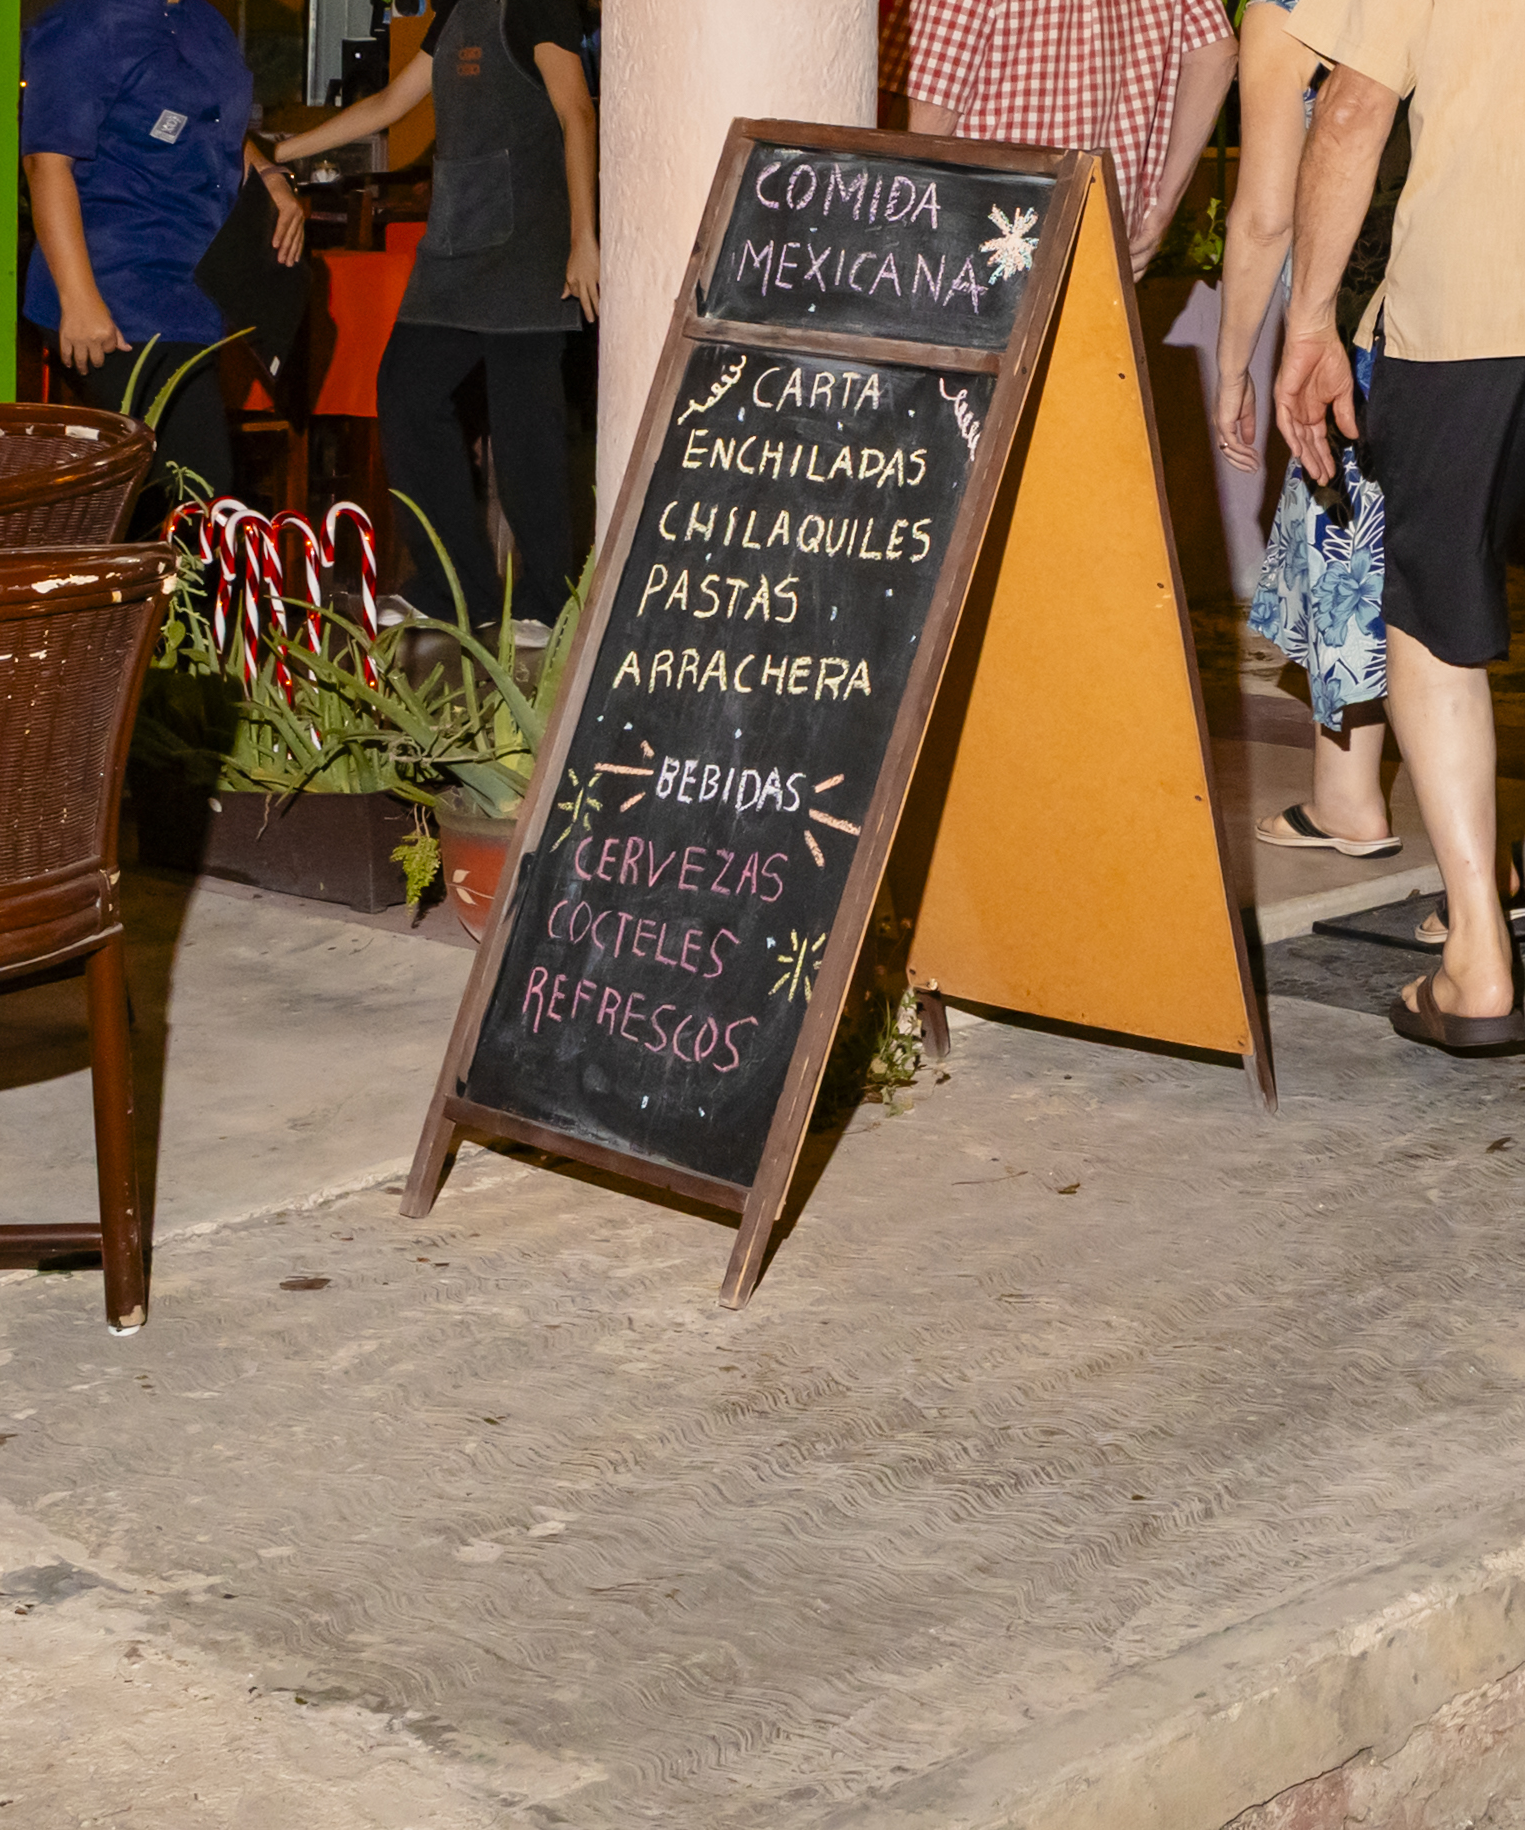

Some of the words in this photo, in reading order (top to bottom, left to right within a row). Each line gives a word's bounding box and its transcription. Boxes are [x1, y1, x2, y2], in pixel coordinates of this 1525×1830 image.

[756, 162, 942, 229] COMIDA
[736, 239, 991, 313] MEXICANA
[752, 366, 884, 411] CARTA
[681, 428, 928, 488] ENCHILADAS
[659, 500, 932, 563] CHILAQUILES
[637, 564, 799, 624] PASTAS
[612, 649, 873, 701] ARRACHERA
[655, 756, 807, 812] BEBIDAS
[575, 835, 790, 903] CERVEZAS
[548, 899, 741, 978] COCTELES
[522, 966, 758, 1072] REFRESCOS
